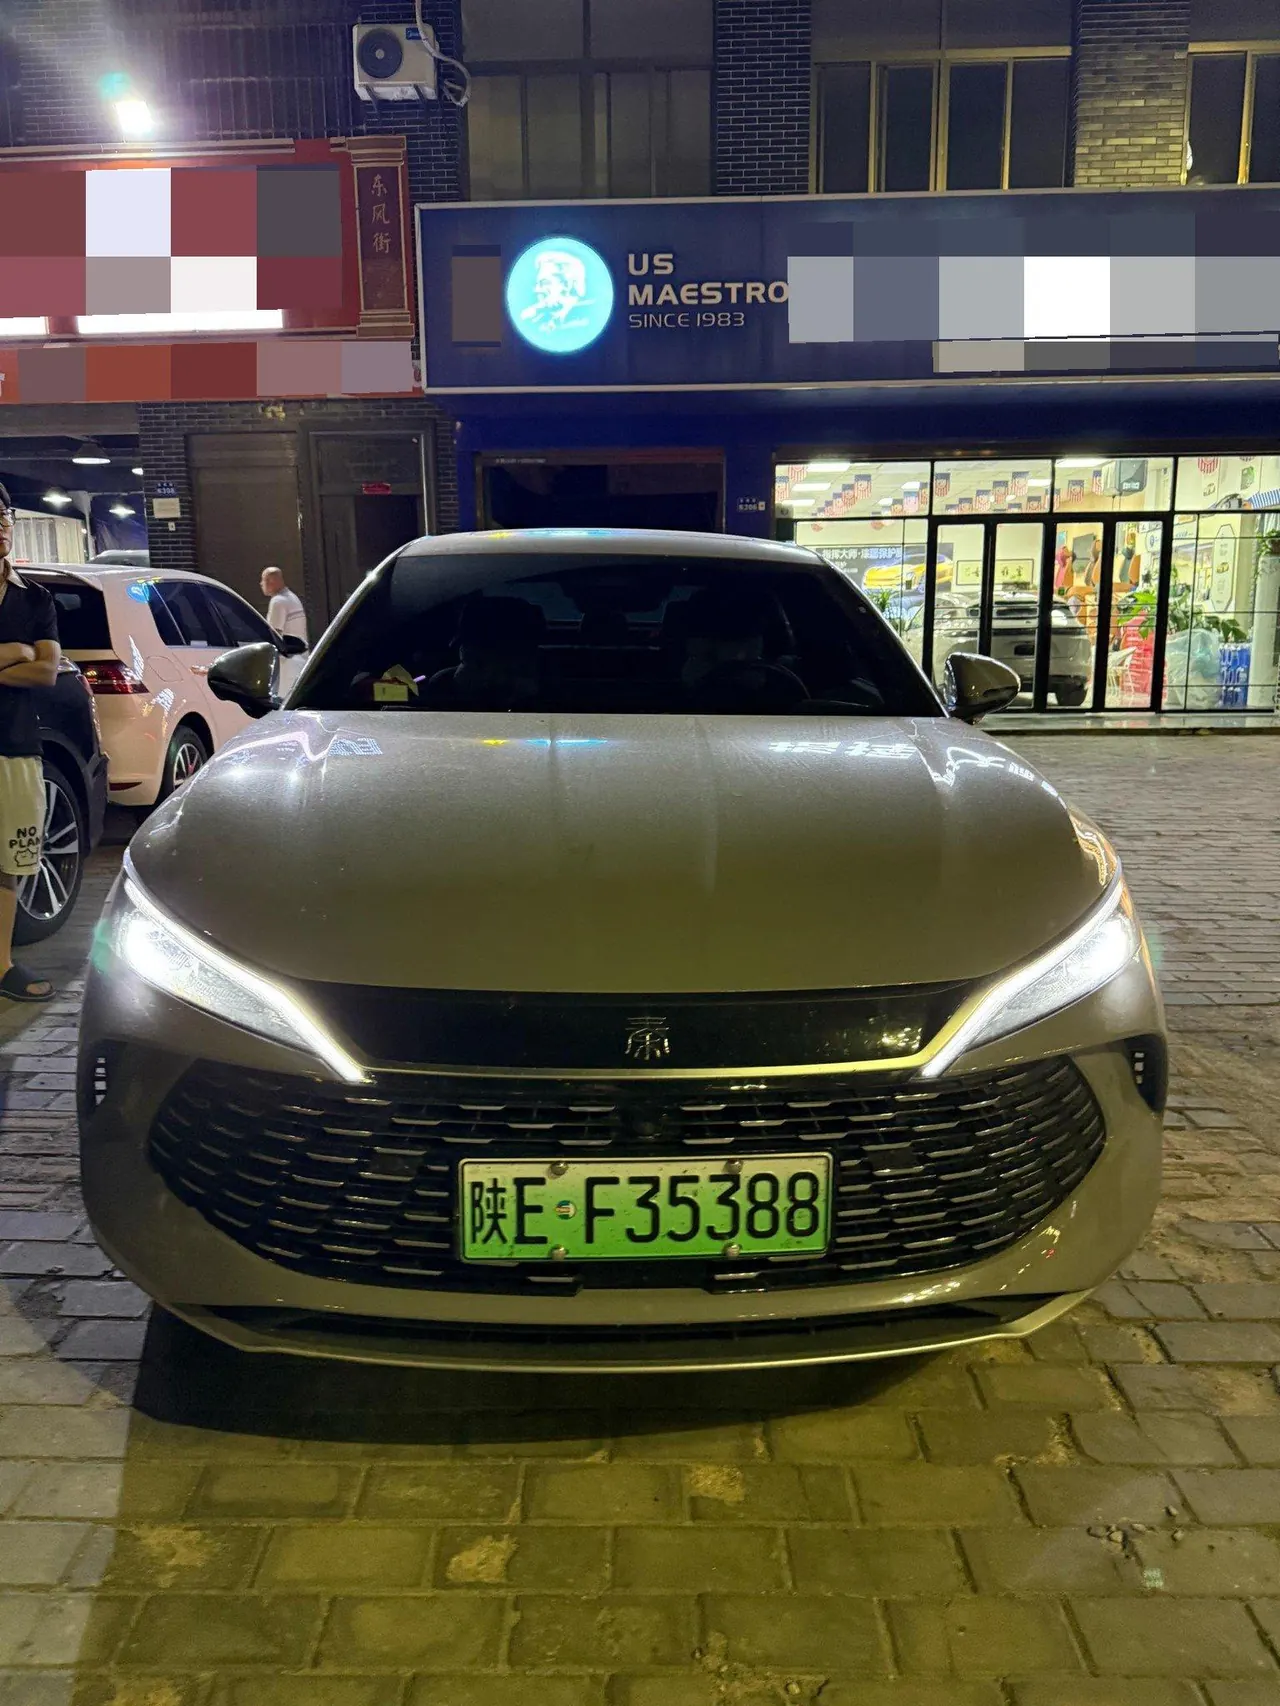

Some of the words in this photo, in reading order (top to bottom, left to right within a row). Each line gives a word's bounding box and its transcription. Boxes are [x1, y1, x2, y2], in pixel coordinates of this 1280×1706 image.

[371, 174, 392, 254] 东风街
[628, 253, 674, 276] US
[628, 281, 788, 306] MAESTRO
[629, 313, 690, 328] SINCE
[696, 312, 745, 327] 1983
[17, 826, 37, 838] NO
